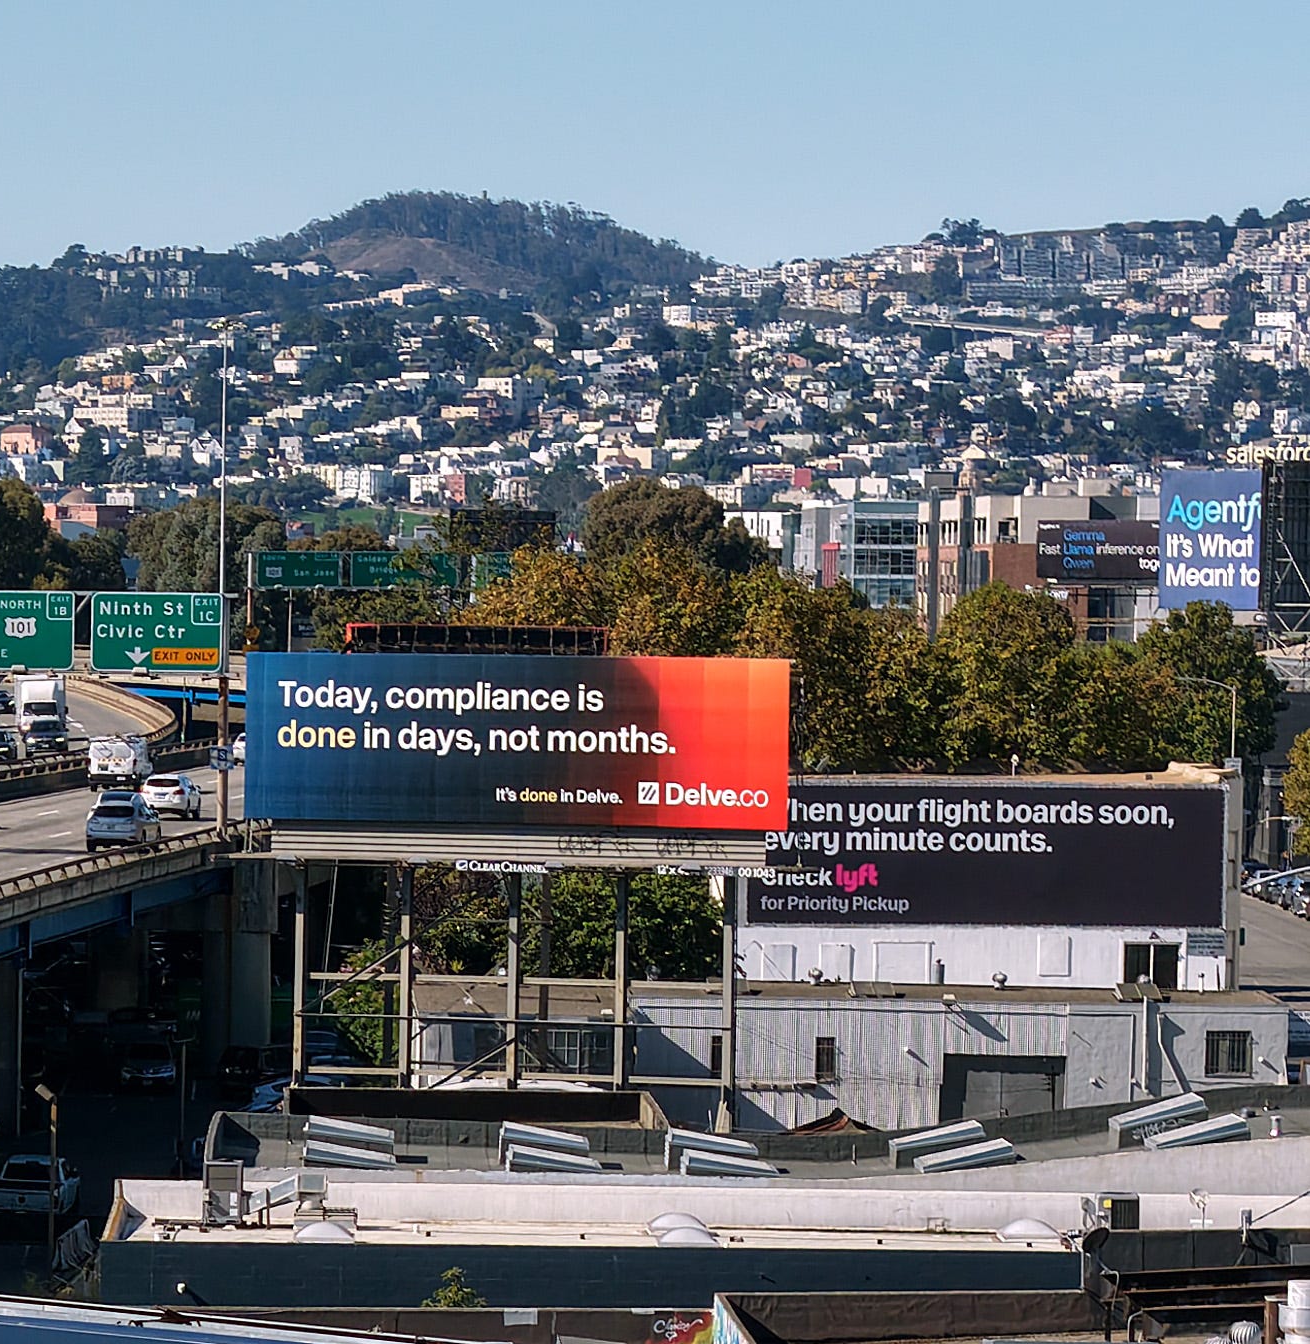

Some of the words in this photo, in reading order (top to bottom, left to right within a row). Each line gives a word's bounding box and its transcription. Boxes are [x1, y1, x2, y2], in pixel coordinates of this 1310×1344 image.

[1227, 441, 1310, 465] salesforc
[1167, 492, 1261, 532] Agentf
[1039, 543, 1062, 555] Fast
[1096, 543, 1144, 556] inference
[1166, 534, 1193, 558] It's
[1198, 534, 1254, 558] What
[1139, 557, 1160, 572] tog
[1165, 563, 1235, 587] Meant
[1239, 566, 1260, 587] to
[0, 600, 42, 610] NORTH
[51, 595, 71, 603] EXIT
[99, 601, 153, 616] Ninth
[163, 602, 184, 616] St
[195, 598, 219, 606] EXIT
[53, 605, 68, 616] 1B
[200, 611, 214, 622] 1C
[10, 622, 33, 633] 101
[97, 624, 144, 638] Civic
[154, 624, 186, 639] Ctr
[154, 651, 179, 662] EXIT
[186, 651, 216, 662] ONLY
[278, 679, 378, 715] Today,
[385, 682, 571, 718] compliance
[578, 683, 604, 712] is
[277, 720, 357, 749] done
[363, 720, 391, 750] in
[397, 721, 481, 757] days,
[488, 725, 540, 753] not
[547, 724, 677, 755] months.
[495, 786, 517, 803] It's
[519, 787, 558, 804] done
[560, 787, 574, 804] in
[575, 787, 623, 805] Delve.
[664, 781, 769, 808] Delve.co
[787, 798, 843, 822] hen
[848, 803, 914, 828] your
[917, 797, 992, 827] flight
[997, 800, 1095, 825] boards
[1098, 803, 1175, 830] soon,
[765, 831, 840, 856] every
[845, 826, 944, 853] minute
[949, 830, 1054, 853] counts.
[835, 863, 879, 893] lyft
[760, 895, 785, 911] for
[787, 895, 849, 914] Priority
[852, 895, 910, 914] Pickup
